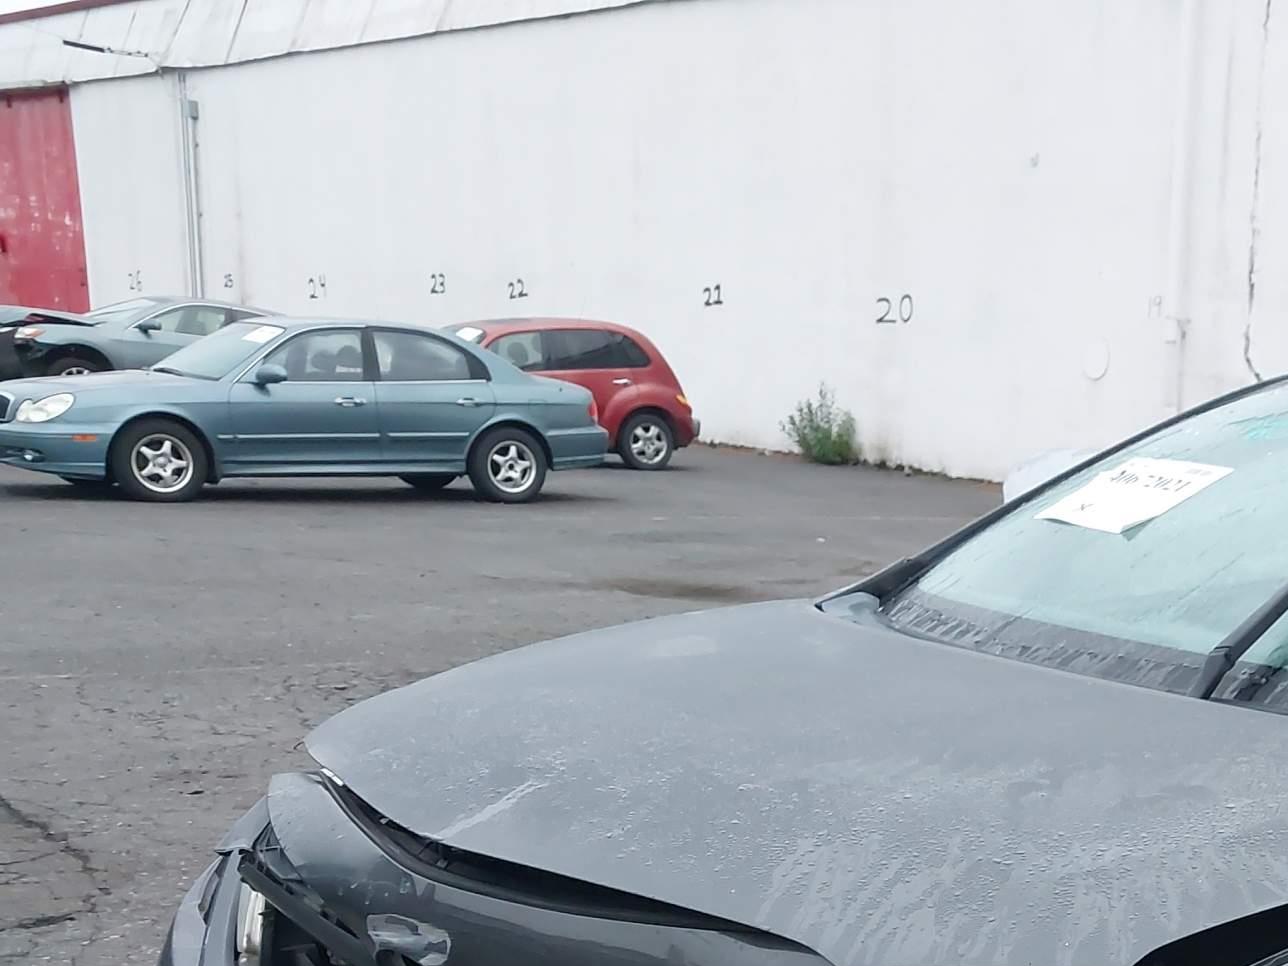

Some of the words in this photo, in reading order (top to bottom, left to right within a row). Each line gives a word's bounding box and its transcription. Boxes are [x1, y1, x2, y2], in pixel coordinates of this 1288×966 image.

[308, 274, 326, 299] 24
[430, 273, 446, 294] 23
[507, 278, 529, 300] 22
[703, 284, 723, 306] 21
[875, 293, 913, 324] 20
